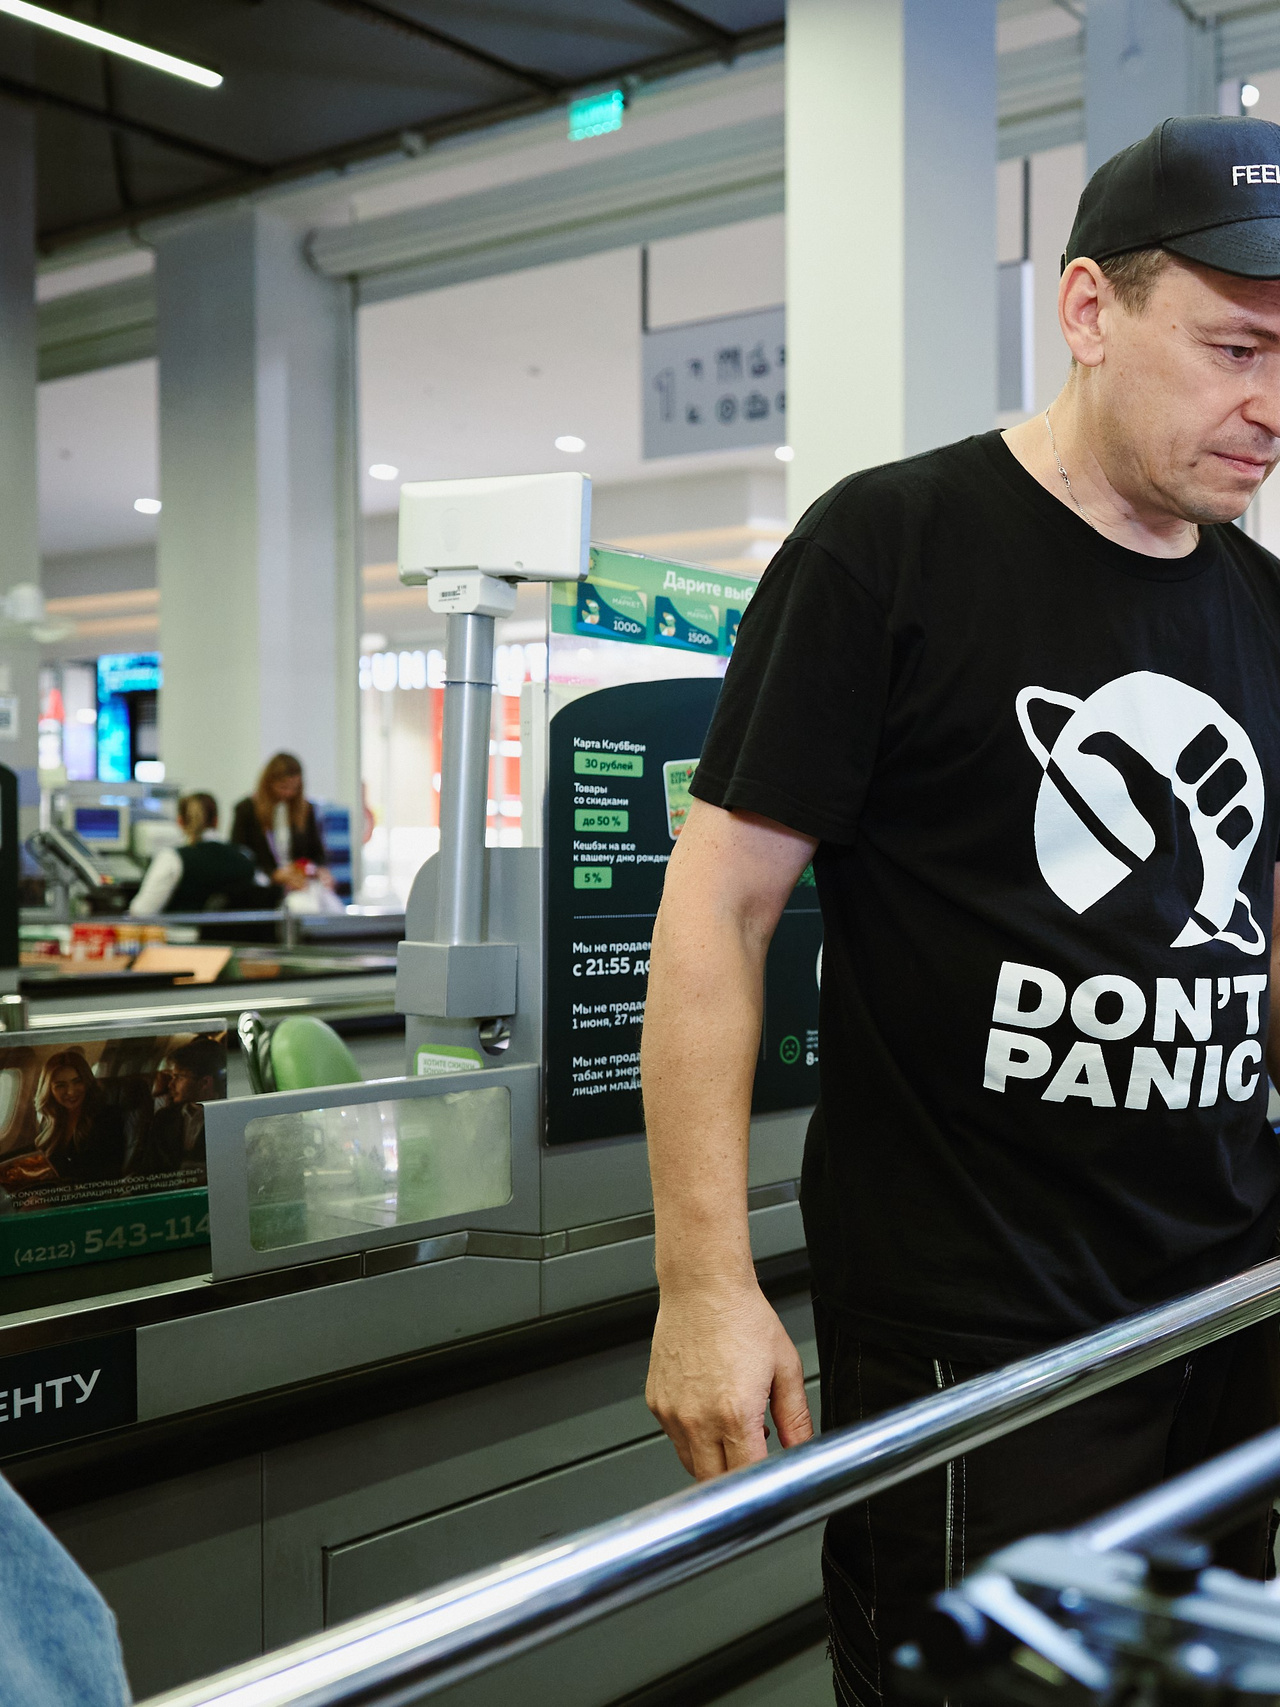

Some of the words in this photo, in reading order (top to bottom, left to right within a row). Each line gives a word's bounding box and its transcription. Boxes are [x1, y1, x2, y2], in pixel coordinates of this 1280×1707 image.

[663, 570, 721, 597] Дарите
[573, 737, 600, 750] Карта
[602, 739, 646, 753] КлубБери
[585, 758, 598, 768] 30
[600, 760, 633, 772] рублей
[573, 782, 608, 796] Товары
[573, 796, 585, 805] со
[586, 796, 629, 807] скидками
[582, 817, 595, 827] до
[597, 816, 610, 826] 50
[611, 816, 621, 827] %
[573, 840, 607, 851] Кешбэк
[608, 842, 620, 851] на
[620, 843, 636, 852] все
[573, 854, 579, 862] к
[580, 854, 614, 865] вашему
[616, 854, 635, 864] дню
[584, 873, 591, 883] 5
[592, 872, 602, 884] %
[572, 942, 592, 954] Мы
[594, 943, 608, 953] не
[572, 963, 582, 977] с
[586, 956, 630, 976] 21:55
[572, 1003, 592, 1015] Мы
[594, 1004, 608, 1014] не
[572, 1018, 578, 1030] 1
[580, 1018, 612, 1029] июня,
[614, 1013, 628, 1026] 27
[572, 1056, 592, 1068] Мы
[594, 1056, 608, 1066] не
[983, 1028, 1262, 1110] PANIC
[572, 1069, 603, 1082] табак
[605, 1069, 613, 1078] и
[572, 1083, 608, 1097] лицам
[12, 1195, 60, 1208] ПРОЕКТНАЯ
[60, 1187, 113, 1203] ДЕКЛАРАЦИЯ
[125, 1183, 150, 1192] САЙТЕ
[14, 1240, 76, 1267] (4212)
[84, 1212, 210, 1254] 543-114
